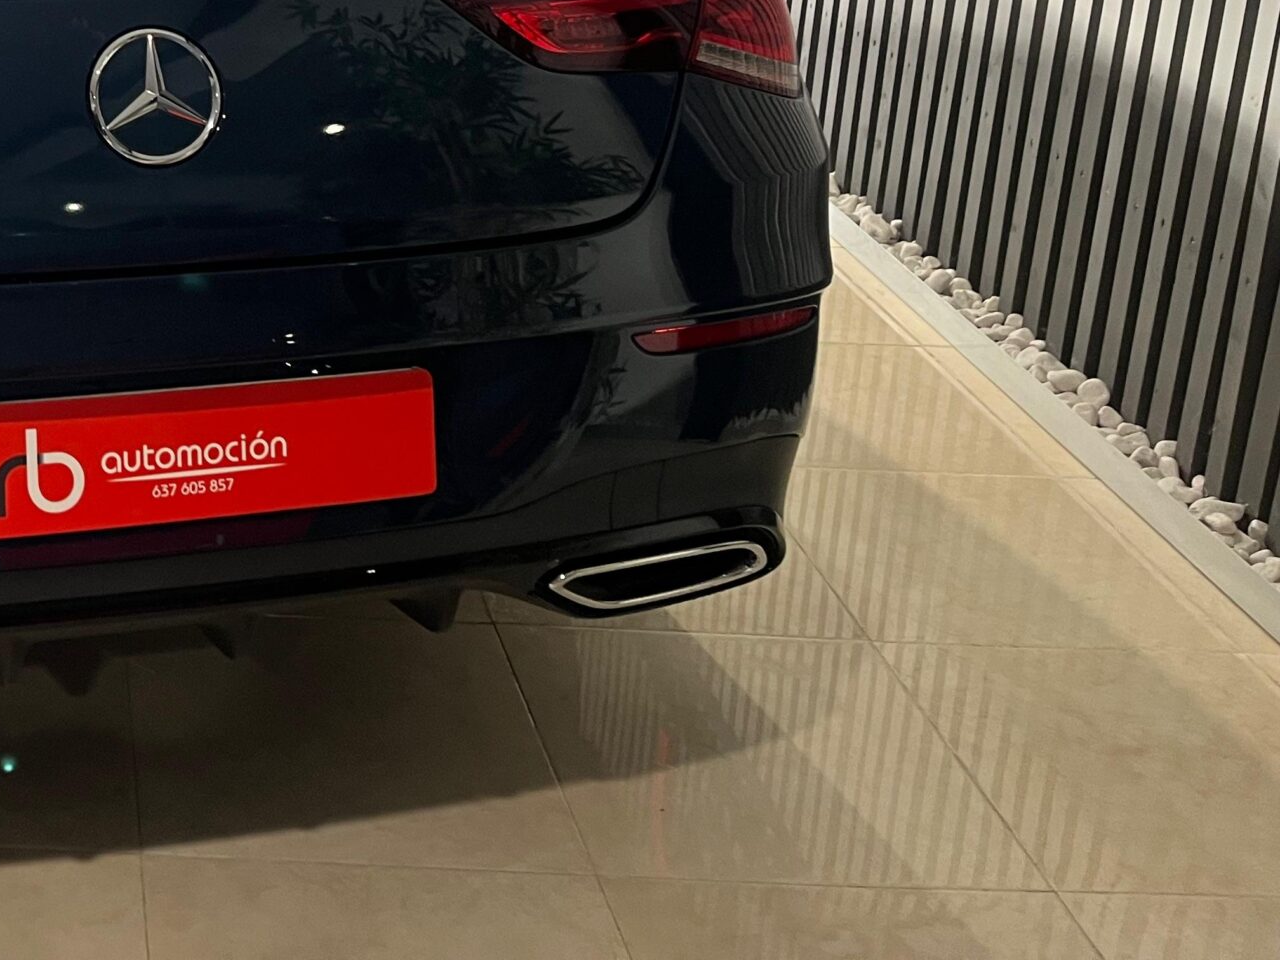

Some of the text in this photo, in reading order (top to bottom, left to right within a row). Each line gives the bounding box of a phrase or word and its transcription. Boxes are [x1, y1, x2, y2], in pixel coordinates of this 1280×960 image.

[101, 431, 287, 474] automoción
[152, 478, 234, 498] 637 605 857
